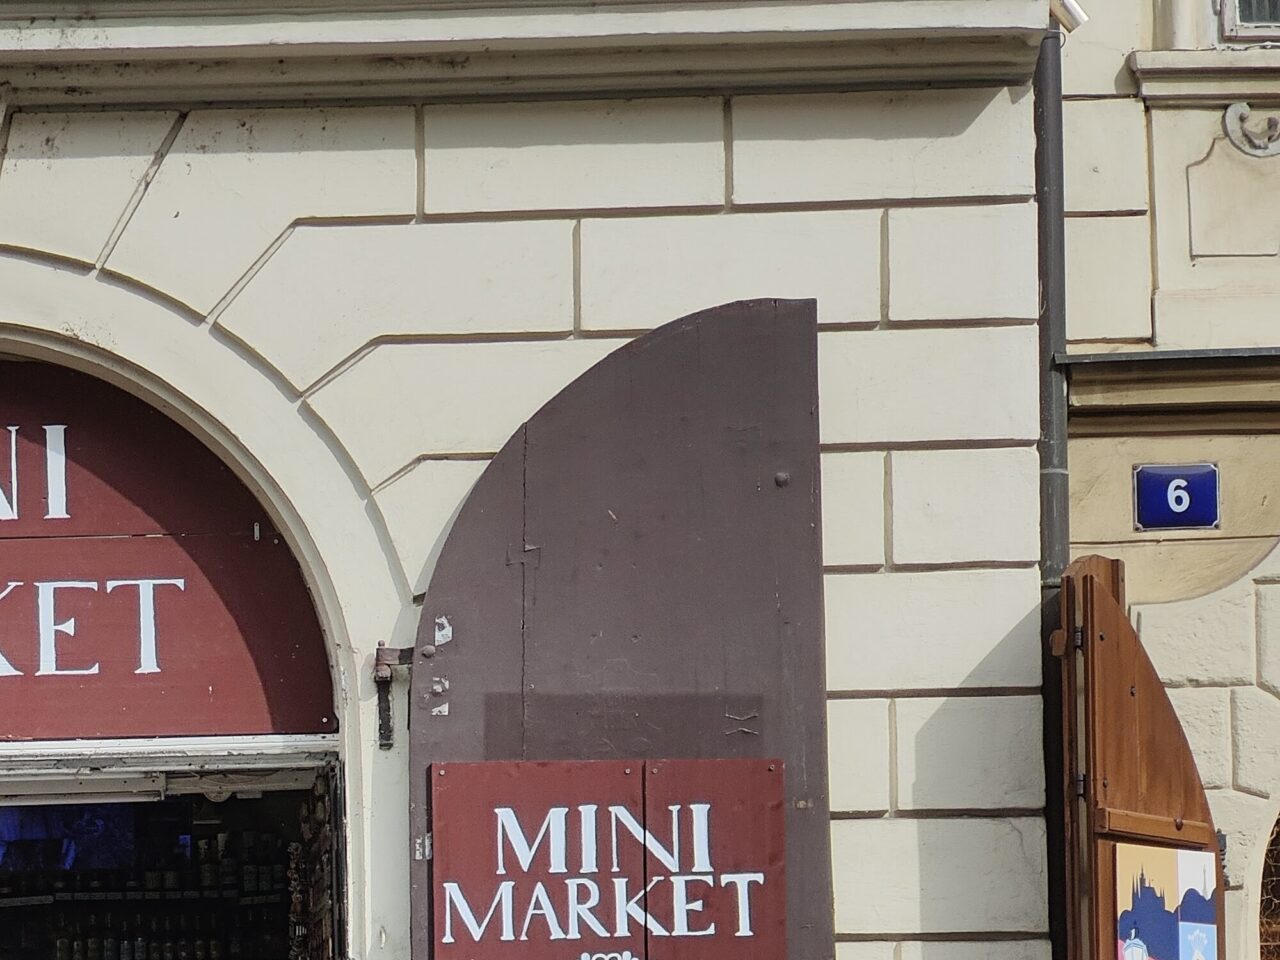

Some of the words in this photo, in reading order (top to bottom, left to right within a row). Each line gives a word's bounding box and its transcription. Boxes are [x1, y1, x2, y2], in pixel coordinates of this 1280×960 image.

[1168, 479, 1189, 512] 6
[494, 804, 714, 874] MINI
[442, 873, 764, 943] MARKET
